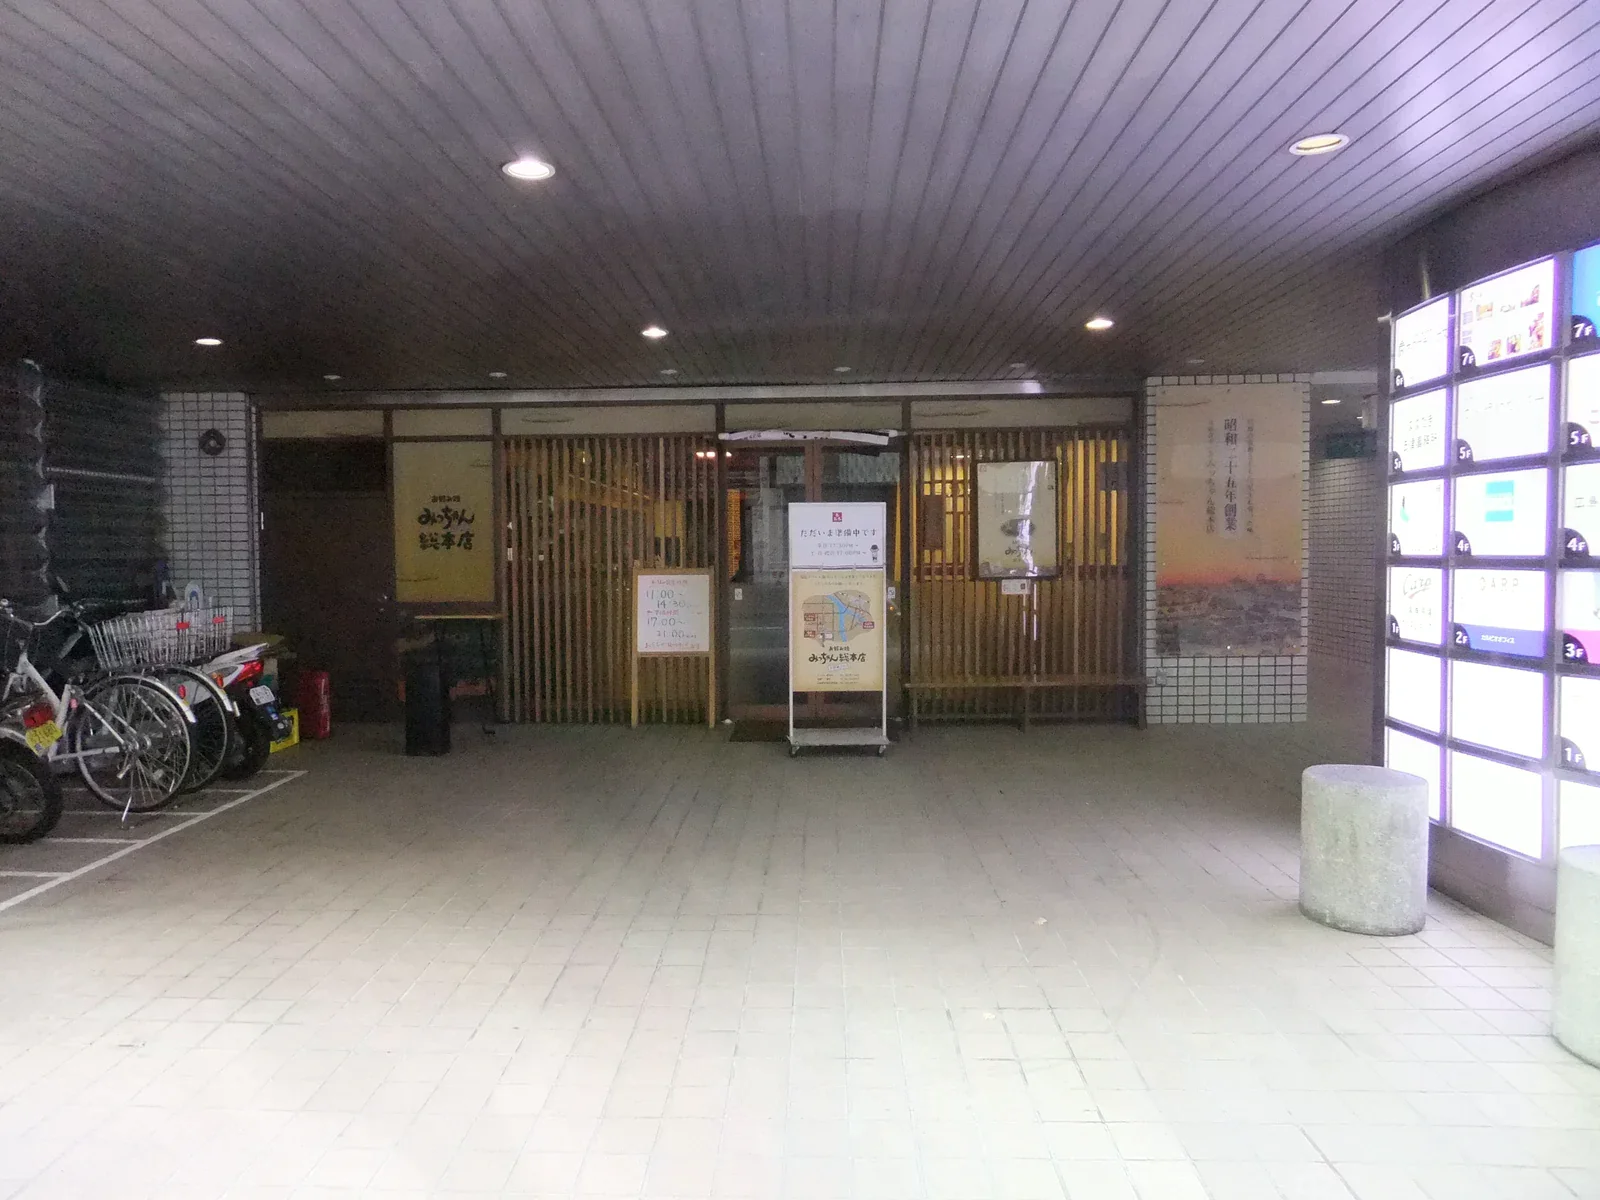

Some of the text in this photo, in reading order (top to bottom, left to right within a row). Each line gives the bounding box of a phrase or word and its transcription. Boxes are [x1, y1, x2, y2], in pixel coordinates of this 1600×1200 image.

[1573, 322, 1593, 338] 7F
[1462, 353, 1475, 366] 7F
[1395, 374, 1404, 386] 6F
[1570, 430, 1589, 445] 5F
[1459, 446, 1471, 460] 5F
[1394, 457, 1402, 470] 5F
[800, 528, 877, 538] ただいま準備中です
[419, 531, 475, 550] 総本店
[1392, 540, 1400, 552] 3F
[1457, 539, 1470, 552] 4F
[1567, 537, 1585, 552] 4F
[1392, 622, 1400, 634] 1F
[1455, 631, 1468, 644] 2F
[1564, 642, 1584, 658] 3F
[808, 652, 867, 665] みっちゃん総本店
[1564, 746, 1582, 764] 1F
